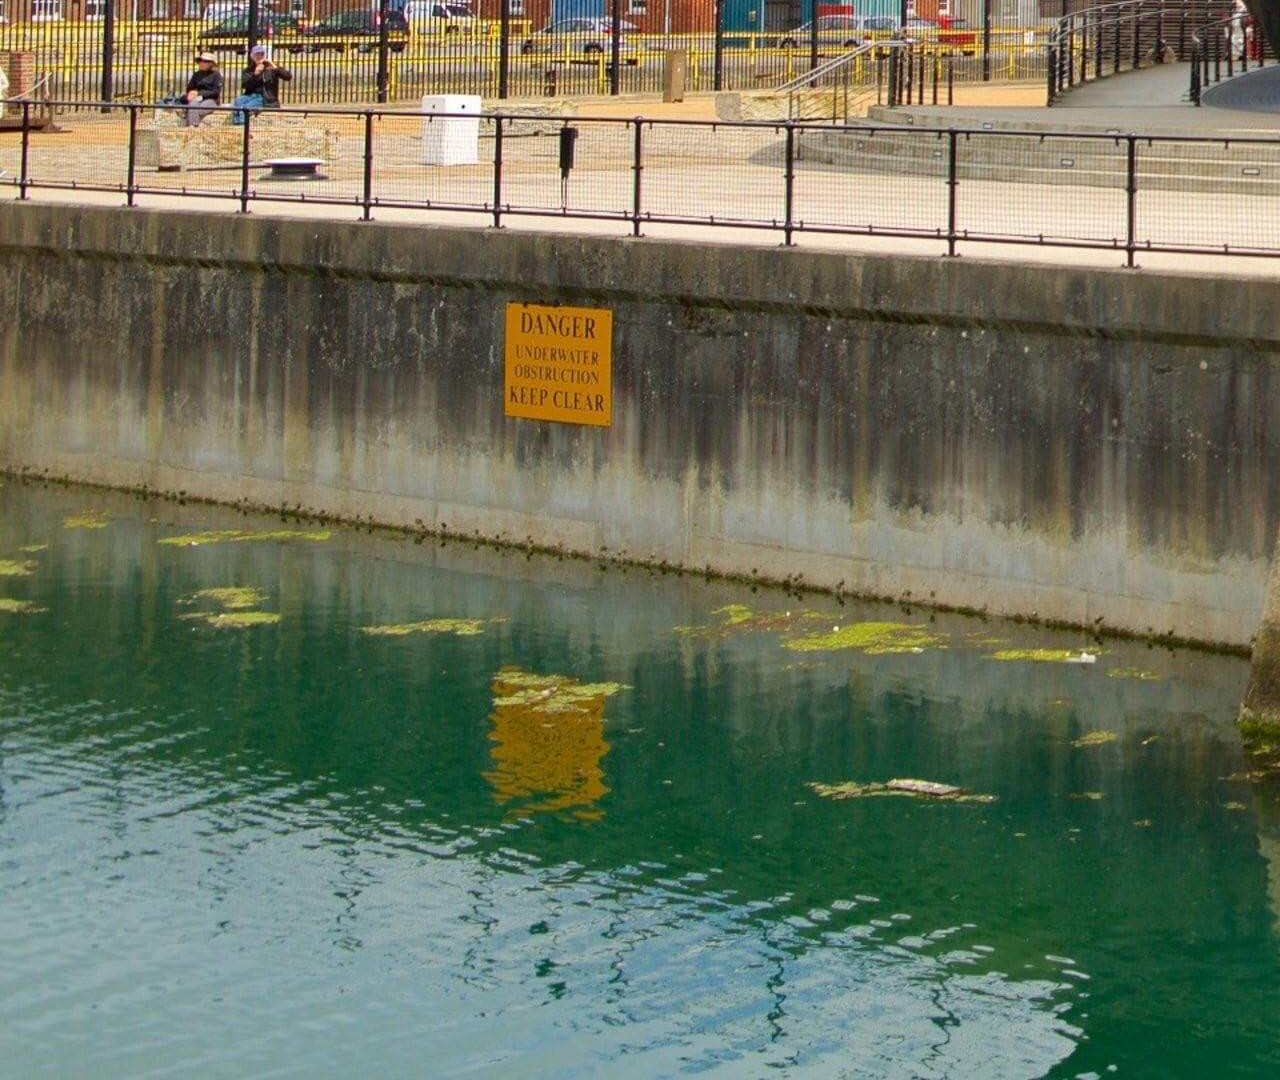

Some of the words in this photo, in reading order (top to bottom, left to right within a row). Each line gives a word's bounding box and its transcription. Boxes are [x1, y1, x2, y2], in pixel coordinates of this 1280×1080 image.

[521, 312, 596, 339] DANGER
[515, 345, 599, 366] UNDERWATER
[514, 364, 600, 385] OBSTRUCTION
[510, 385, 548, 406] KEEP
[553, 390, 604, 412] CLEAR
